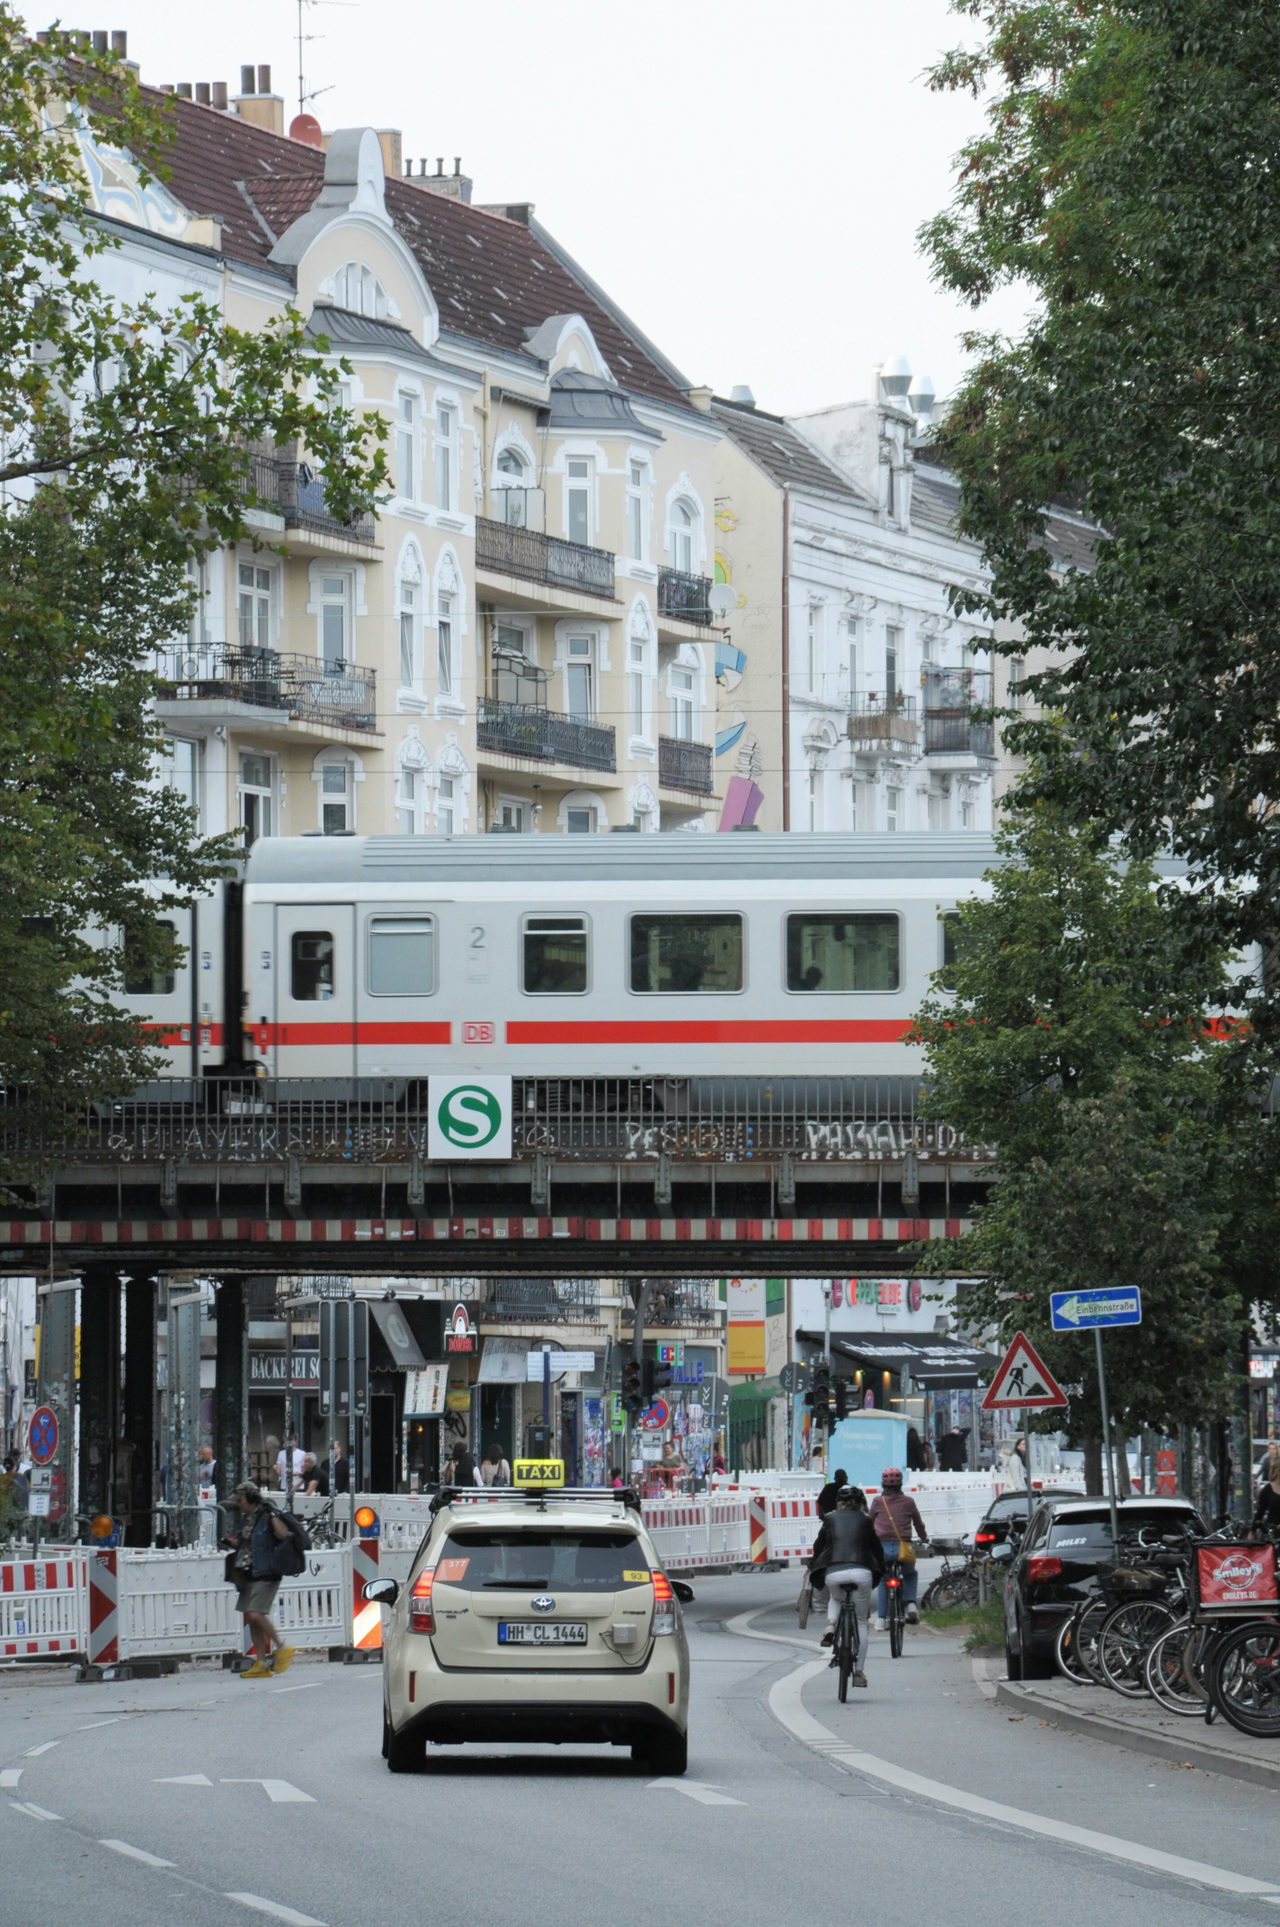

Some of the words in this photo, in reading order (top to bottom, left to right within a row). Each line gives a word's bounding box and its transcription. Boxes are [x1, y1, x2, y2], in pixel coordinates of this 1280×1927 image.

[470, 926, 486, 949] 2
[467, 1025, 491, 1041] DB
[448, 1090, 492, 1144] S
[518, 1465, 560, 1479] TAXI
[1056, 1537, 1088, 1548] MILES
[448, 1559, 466, 1569] 377
[1212, 1562, 1263, 1582] Smiley's
[631, 1572, 643, 1580] 93
[507, 1624, 525, 1640] HH
[533, 1624, 550, 1640] CL
[552, 1624, 585, 1640] 1444
